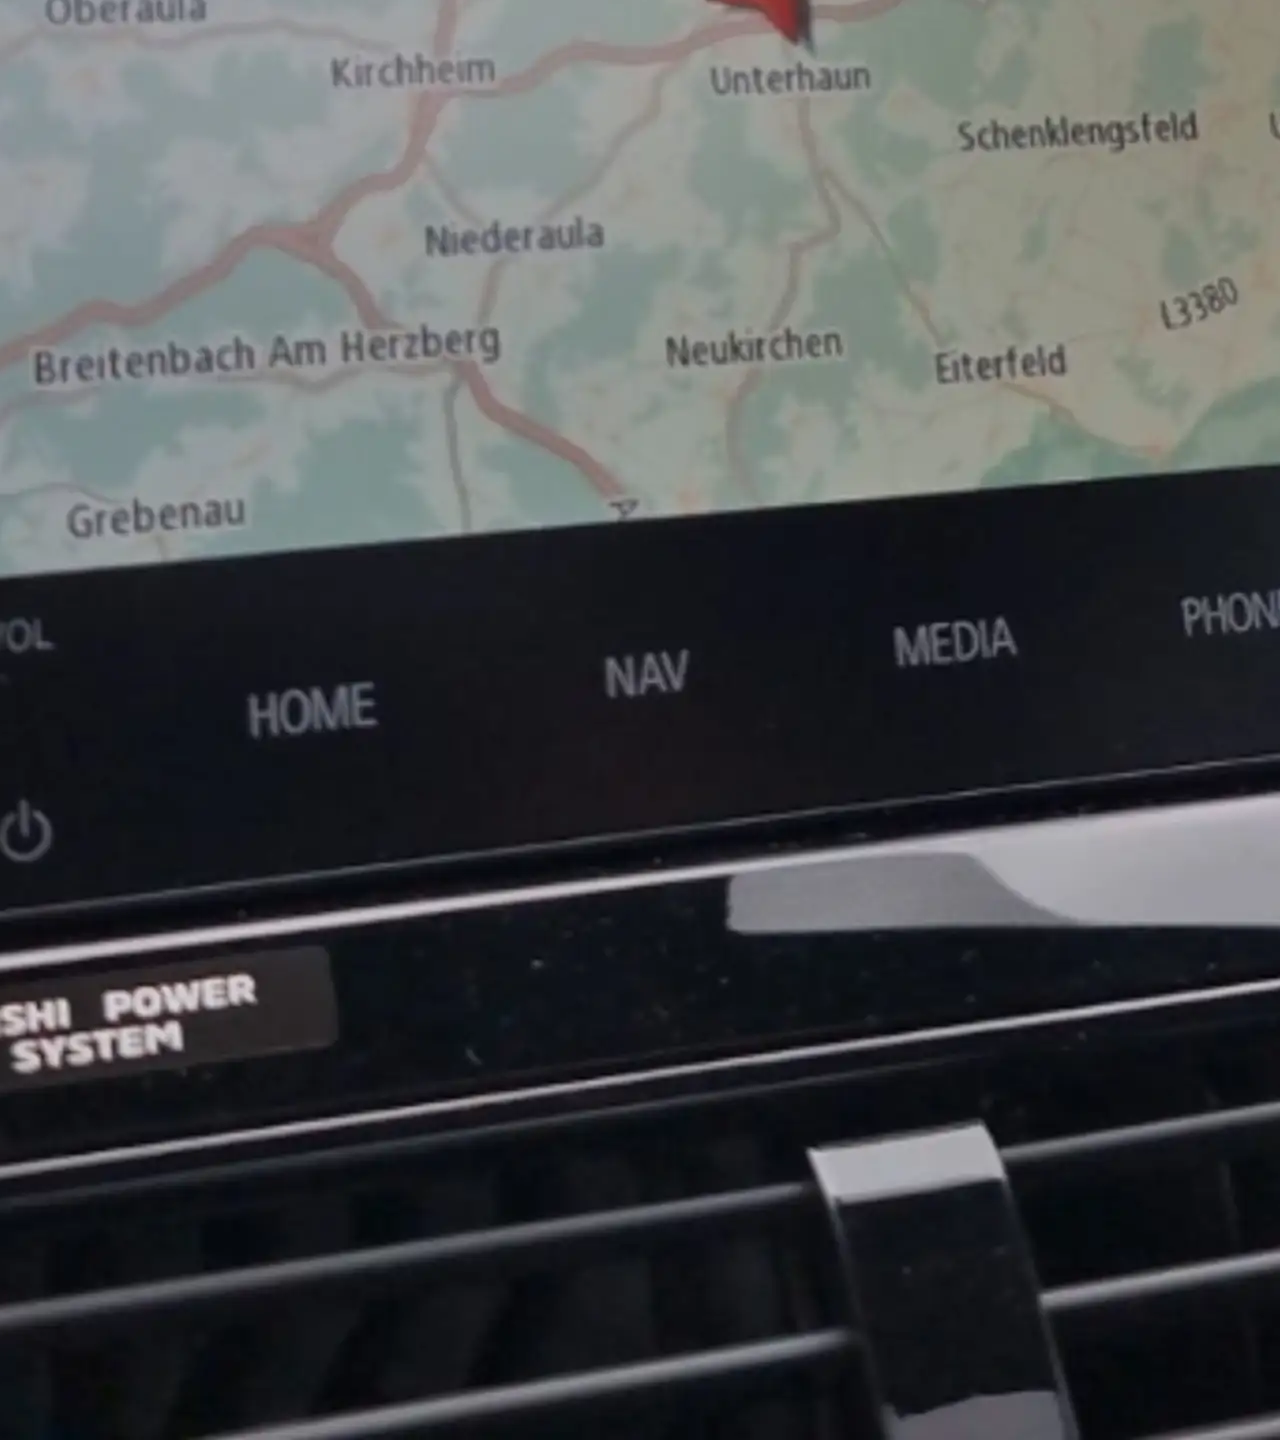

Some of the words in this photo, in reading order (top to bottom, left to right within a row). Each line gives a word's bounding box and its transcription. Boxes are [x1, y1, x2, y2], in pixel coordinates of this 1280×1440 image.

[330, 55, 496, 89] Kirchheim
[709, 62, 871, 96] Unterhaun
[957, 111, 1200, 152] Schenklengsfeld
[424, 216, 606, 257] Niederaula
[1160, 276, 1239, 331] L3380
[34, 336, 257, 385] Breitenbach
[269, 331, 329, 366] Am
[341, 323, 502, 363] Herzberg
[665, 327, 844, 367] Neukirchen
[935, 346, 1069, 385] Eiterfeld
[68, 497, 246, 539] Grebenau
[893, 617, 1018, 667] MEDIA
[604, 650, 690, 699] NAV
[247, 681, 379, 739] HOME
[103, 972, 257, 1021] POWER
[11, 1021, 185, 1074] SYSTEM
